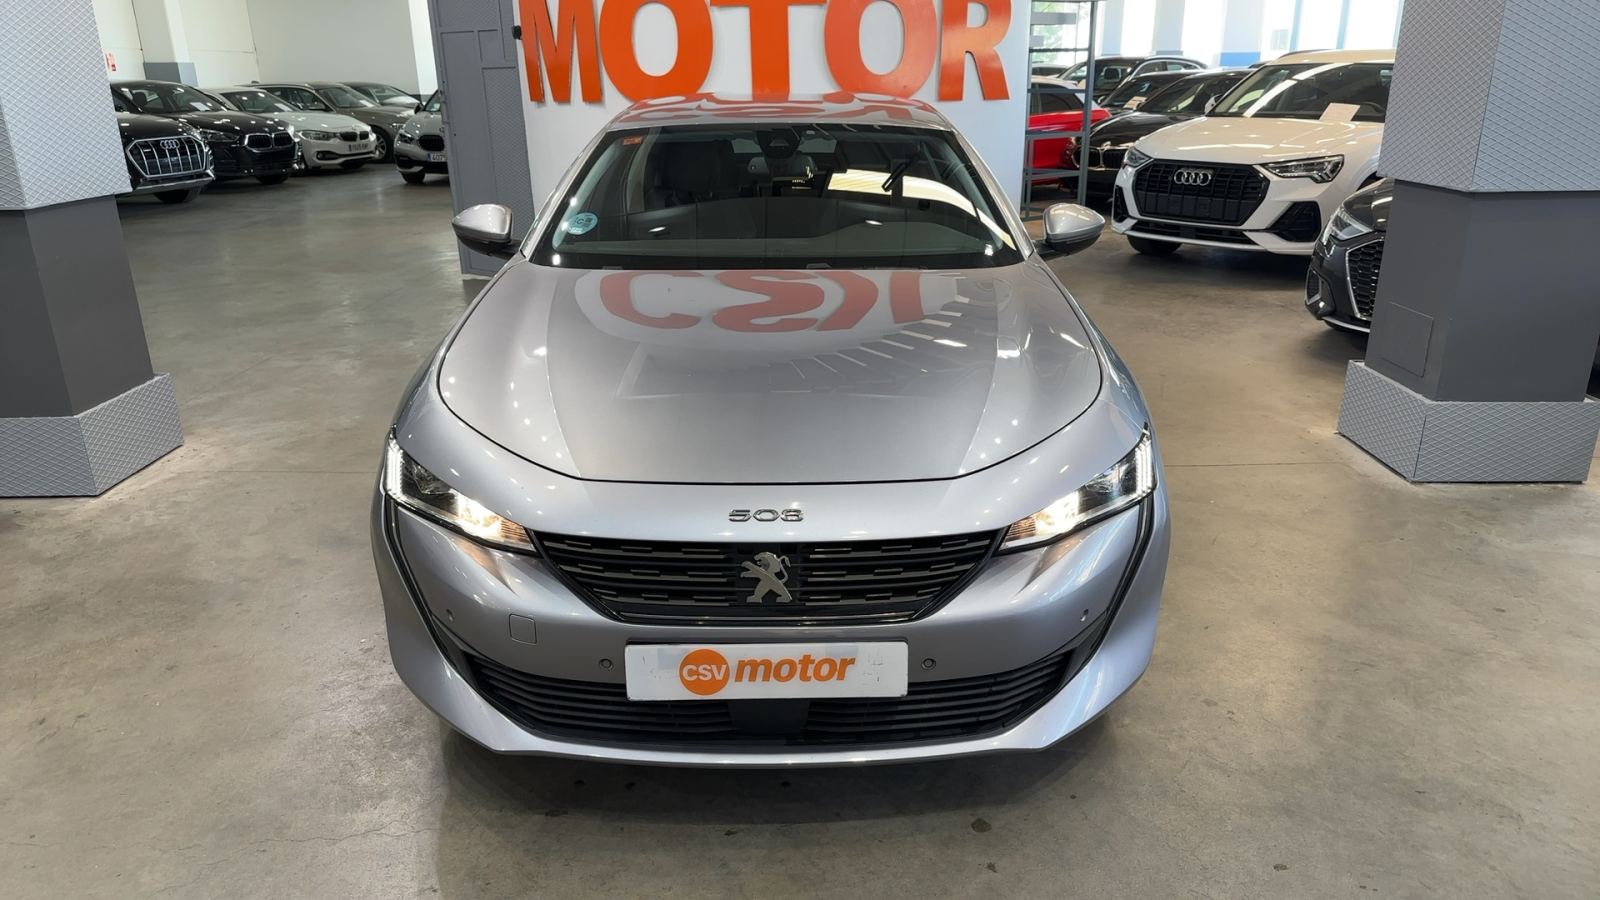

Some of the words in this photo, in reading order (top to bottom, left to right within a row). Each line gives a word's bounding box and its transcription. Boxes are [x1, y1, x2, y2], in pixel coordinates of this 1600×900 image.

[518, 0, 1012, 103] MOTOR
[728, 508, 804, 522] 508
[682, 664, 728, 681] CSV
[734, 654, 856, 683] motor
